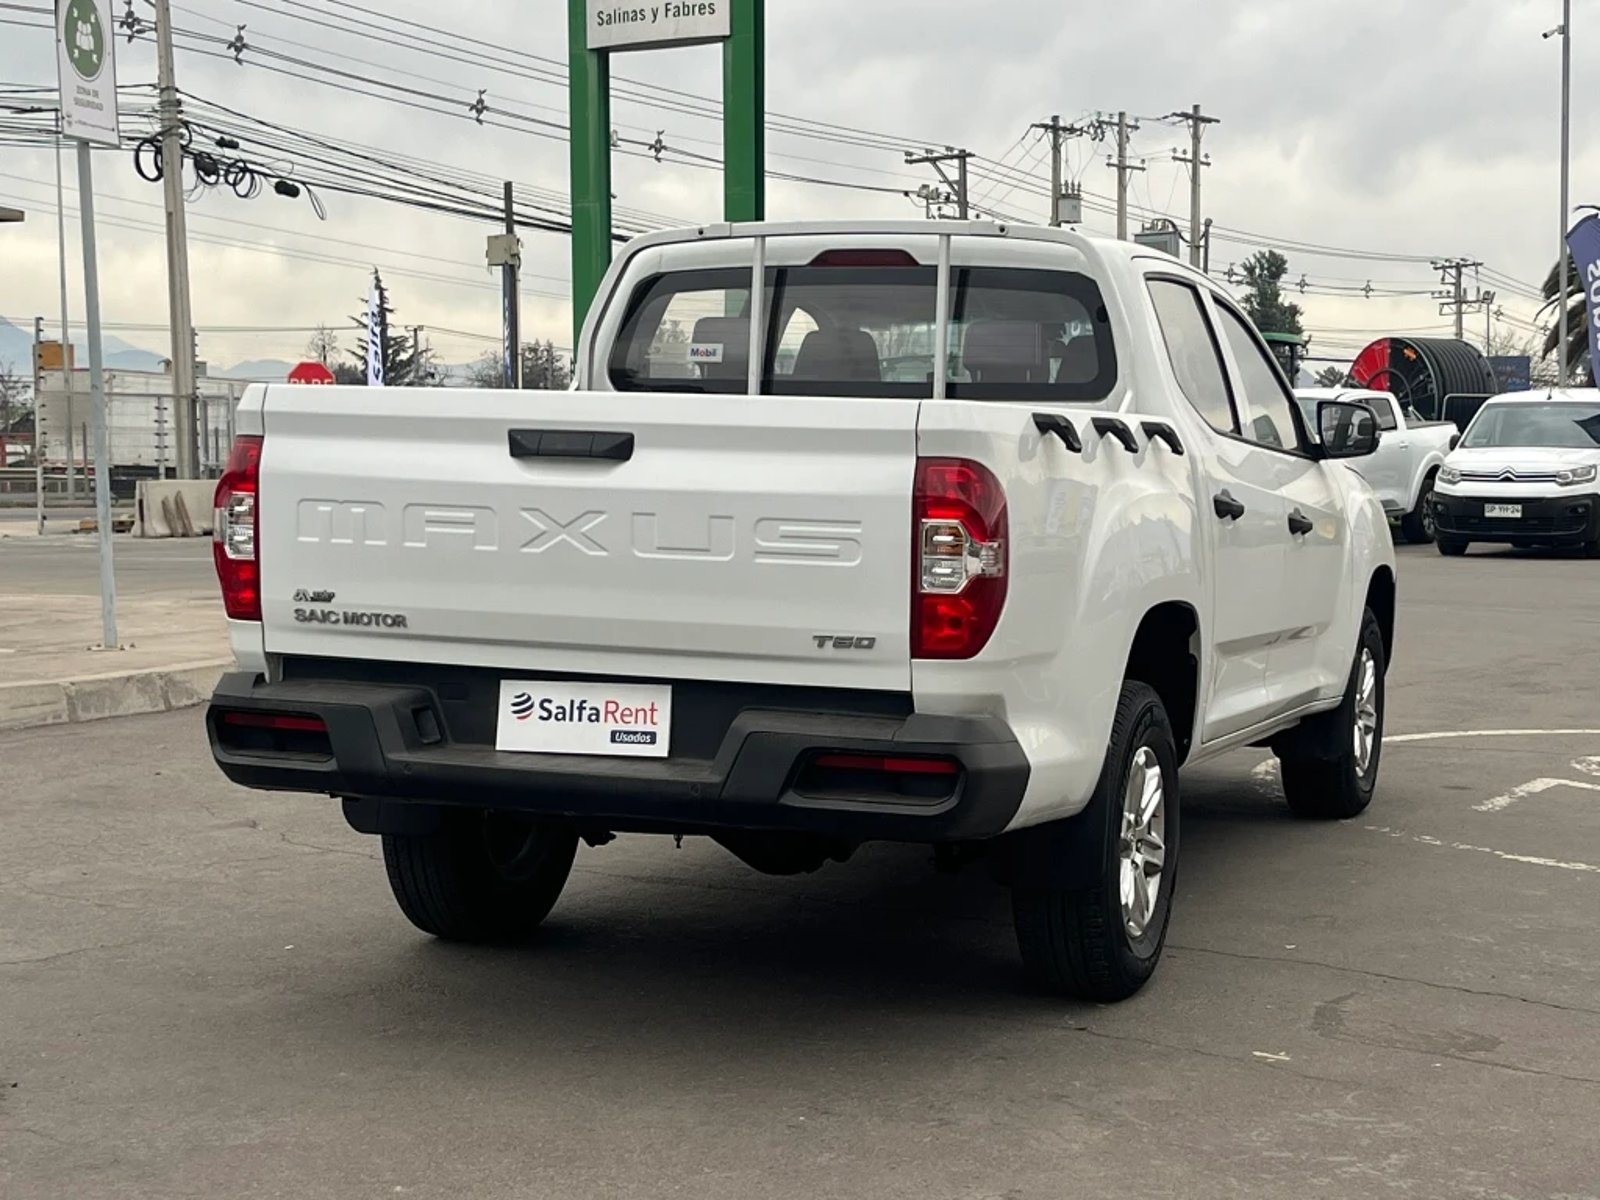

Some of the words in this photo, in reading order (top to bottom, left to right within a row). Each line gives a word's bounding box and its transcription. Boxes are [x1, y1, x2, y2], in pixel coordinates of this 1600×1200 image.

[597, 8, 646, 26] Salinas
[651, 7, 659, 23] y
[665, 2, 716, 18] Fabres
[690, 348, 717, 357] Mobil
[297, 498, 862, 567] MAXUS
[294, 608, 341, 624] SAIC
[343, 611, 408, 628] MOTOR
[812, 635, 876, 649] T60
[538, 698, 658, 726] SalfaRent
[615, 732, 651, 743] Usados
